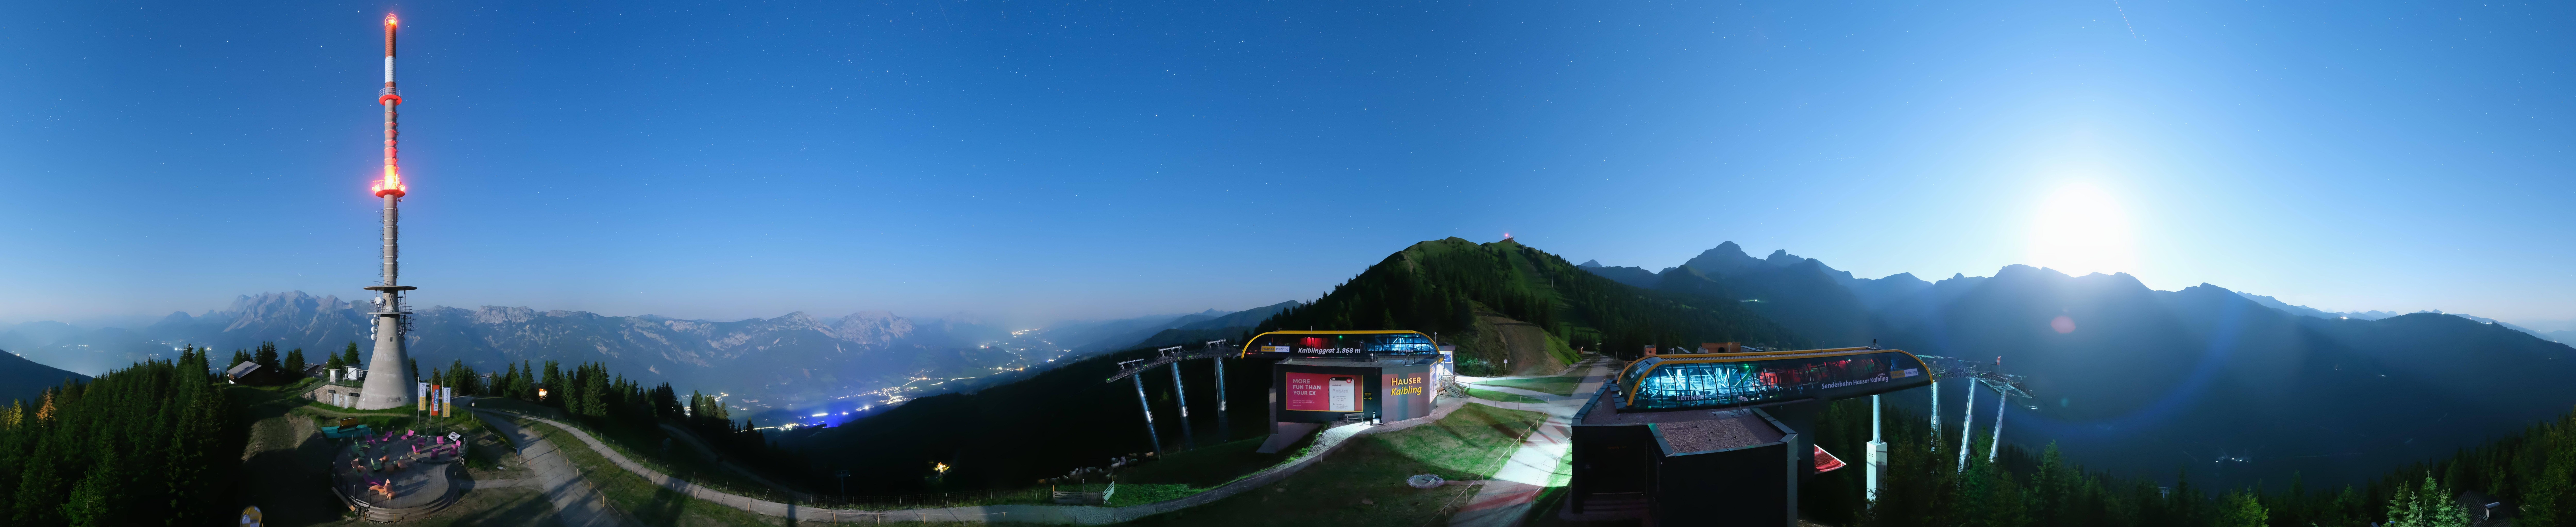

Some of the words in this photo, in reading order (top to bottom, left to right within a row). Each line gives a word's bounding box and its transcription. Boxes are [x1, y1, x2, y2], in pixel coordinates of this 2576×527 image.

[1391, 377, 1421, 386] HAUSER
[1822, 380, 1852, 389] Senderbahn
[1391, 386, 1422, 396] Kaibling
